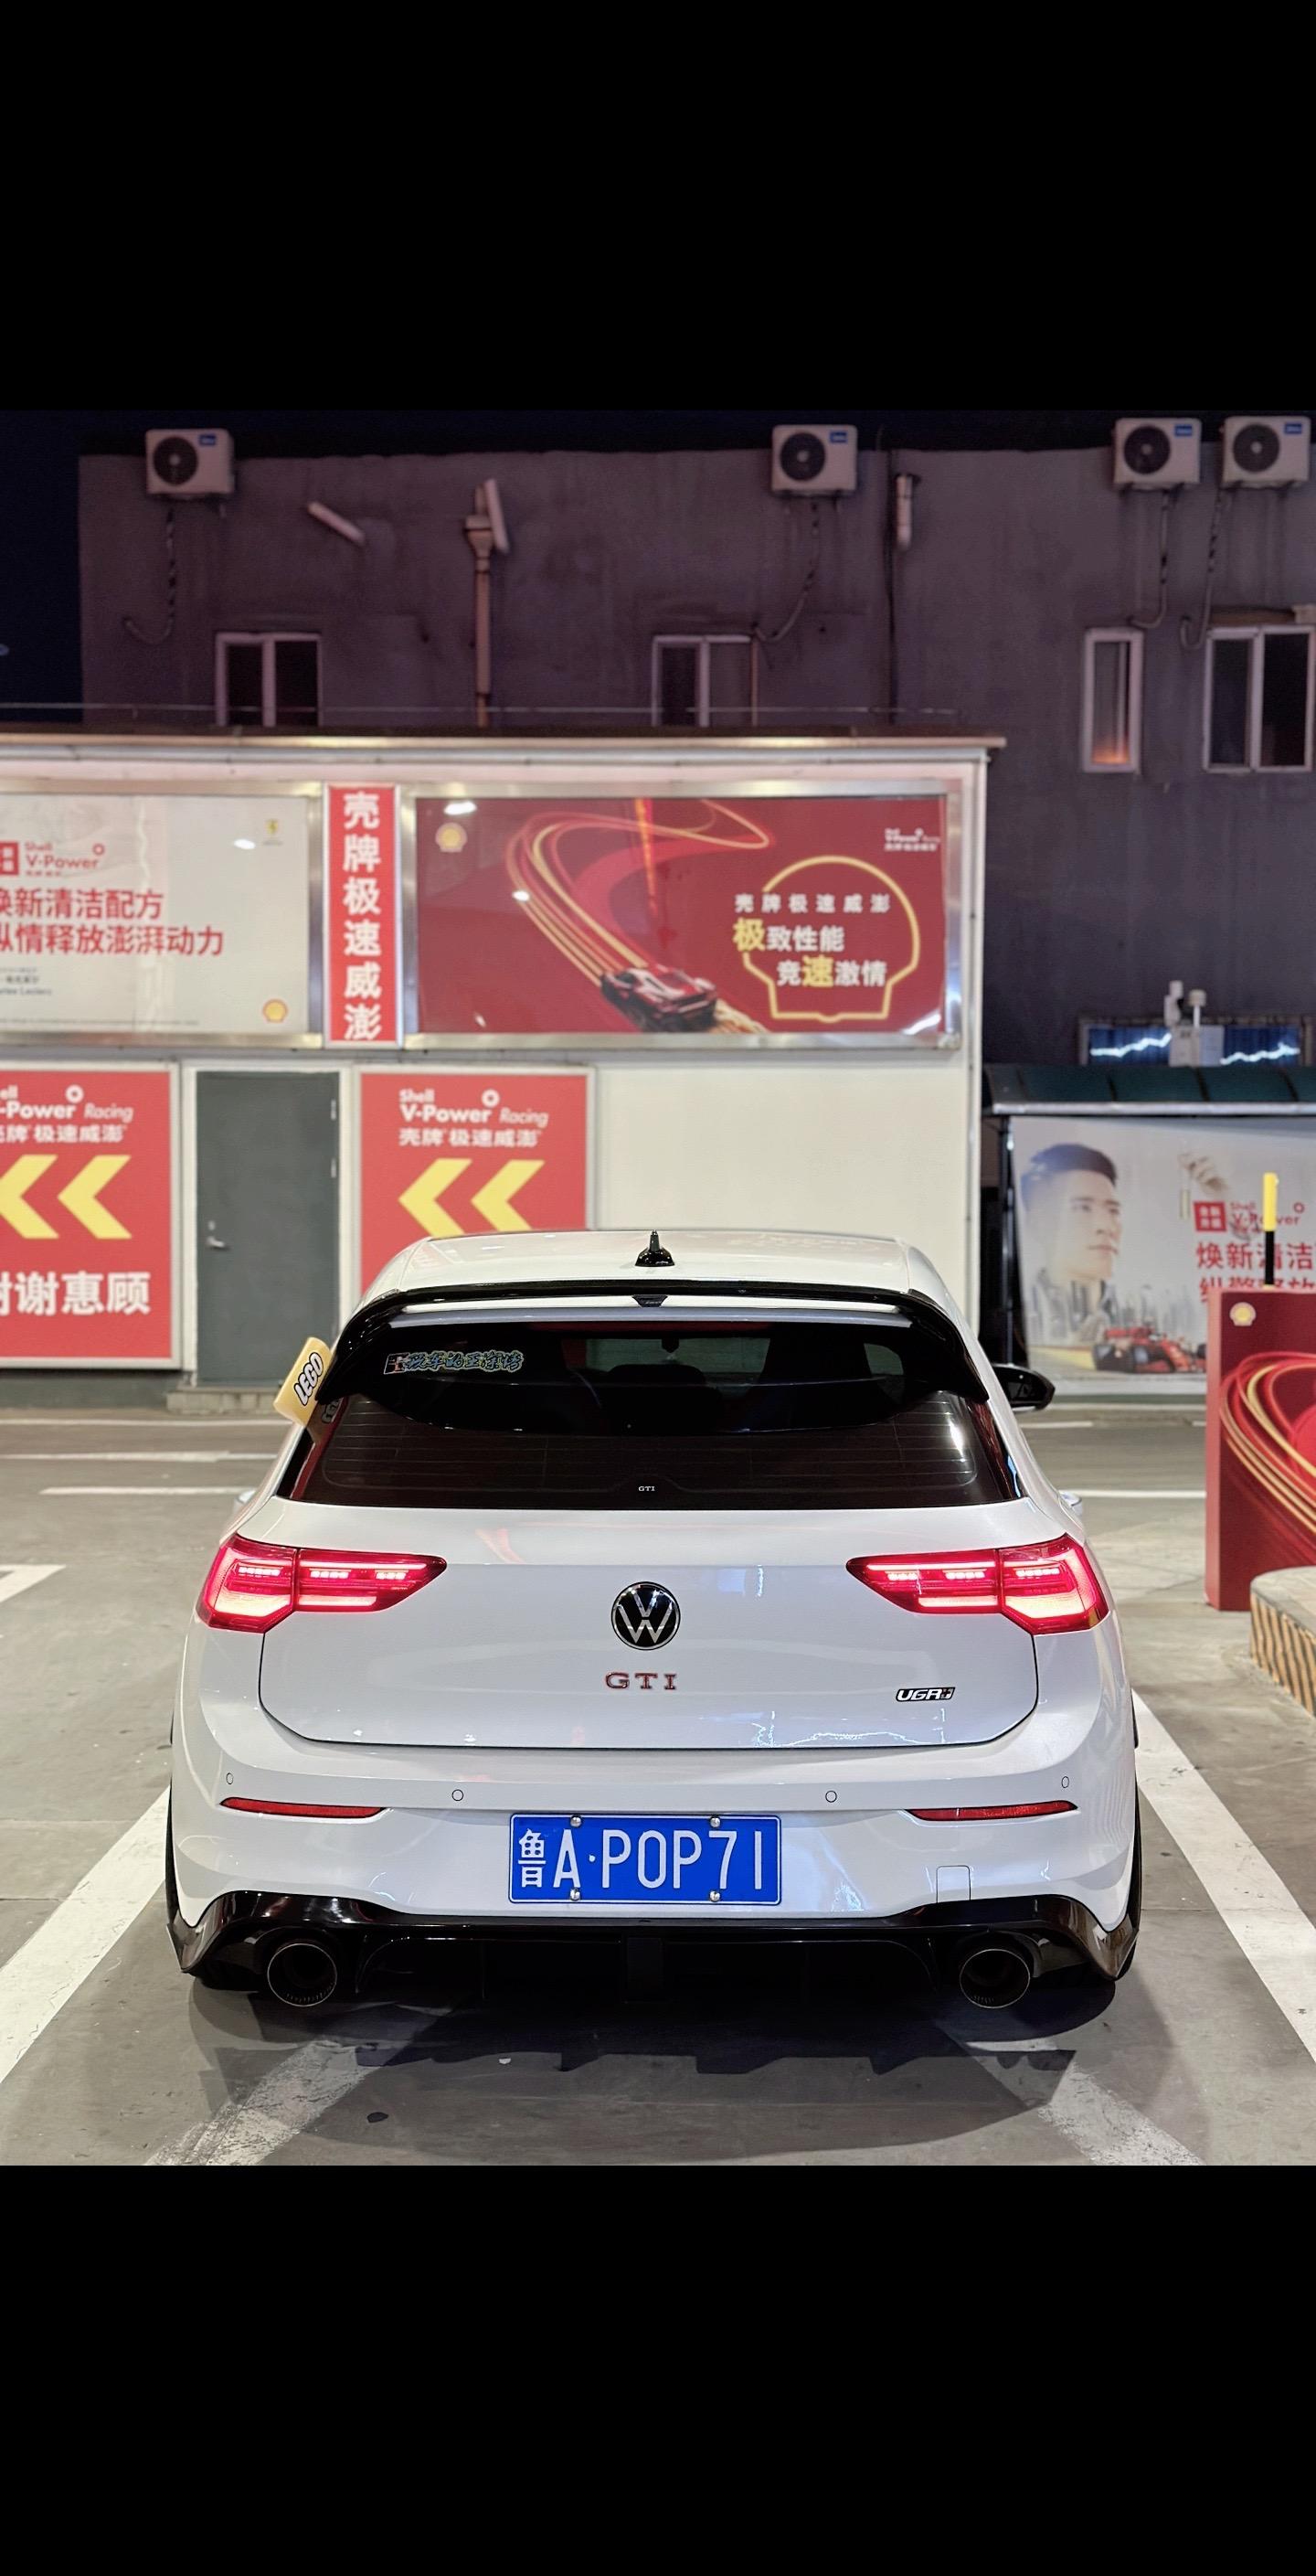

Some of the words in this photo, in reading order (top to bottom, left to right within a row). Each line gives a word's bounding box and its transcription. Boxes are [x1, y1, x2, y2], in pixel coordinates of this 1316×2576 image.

[26, 854, 99, 868] V-Power
[343, 792, 382, 1040] 壳牌极速威澎
[735, 893, 890, 913] 壳牌极速威澎
[733, 918, 844, 952] 极致性能
[777, 955, 887, 987] 竞速激情
[83, 1102, 134, 1123] Racing
[399, 1103, 492, 1123] V-Power
[499, 1107, 549, 1130] Racing
[0, 1124, 124, 1144] 牌极速威澎
[0, 1271, 151, 1316] 谢惠顾
[293, 1351, 324, 1406] LEGO
[605, 1672, 677, 1690] GTI
